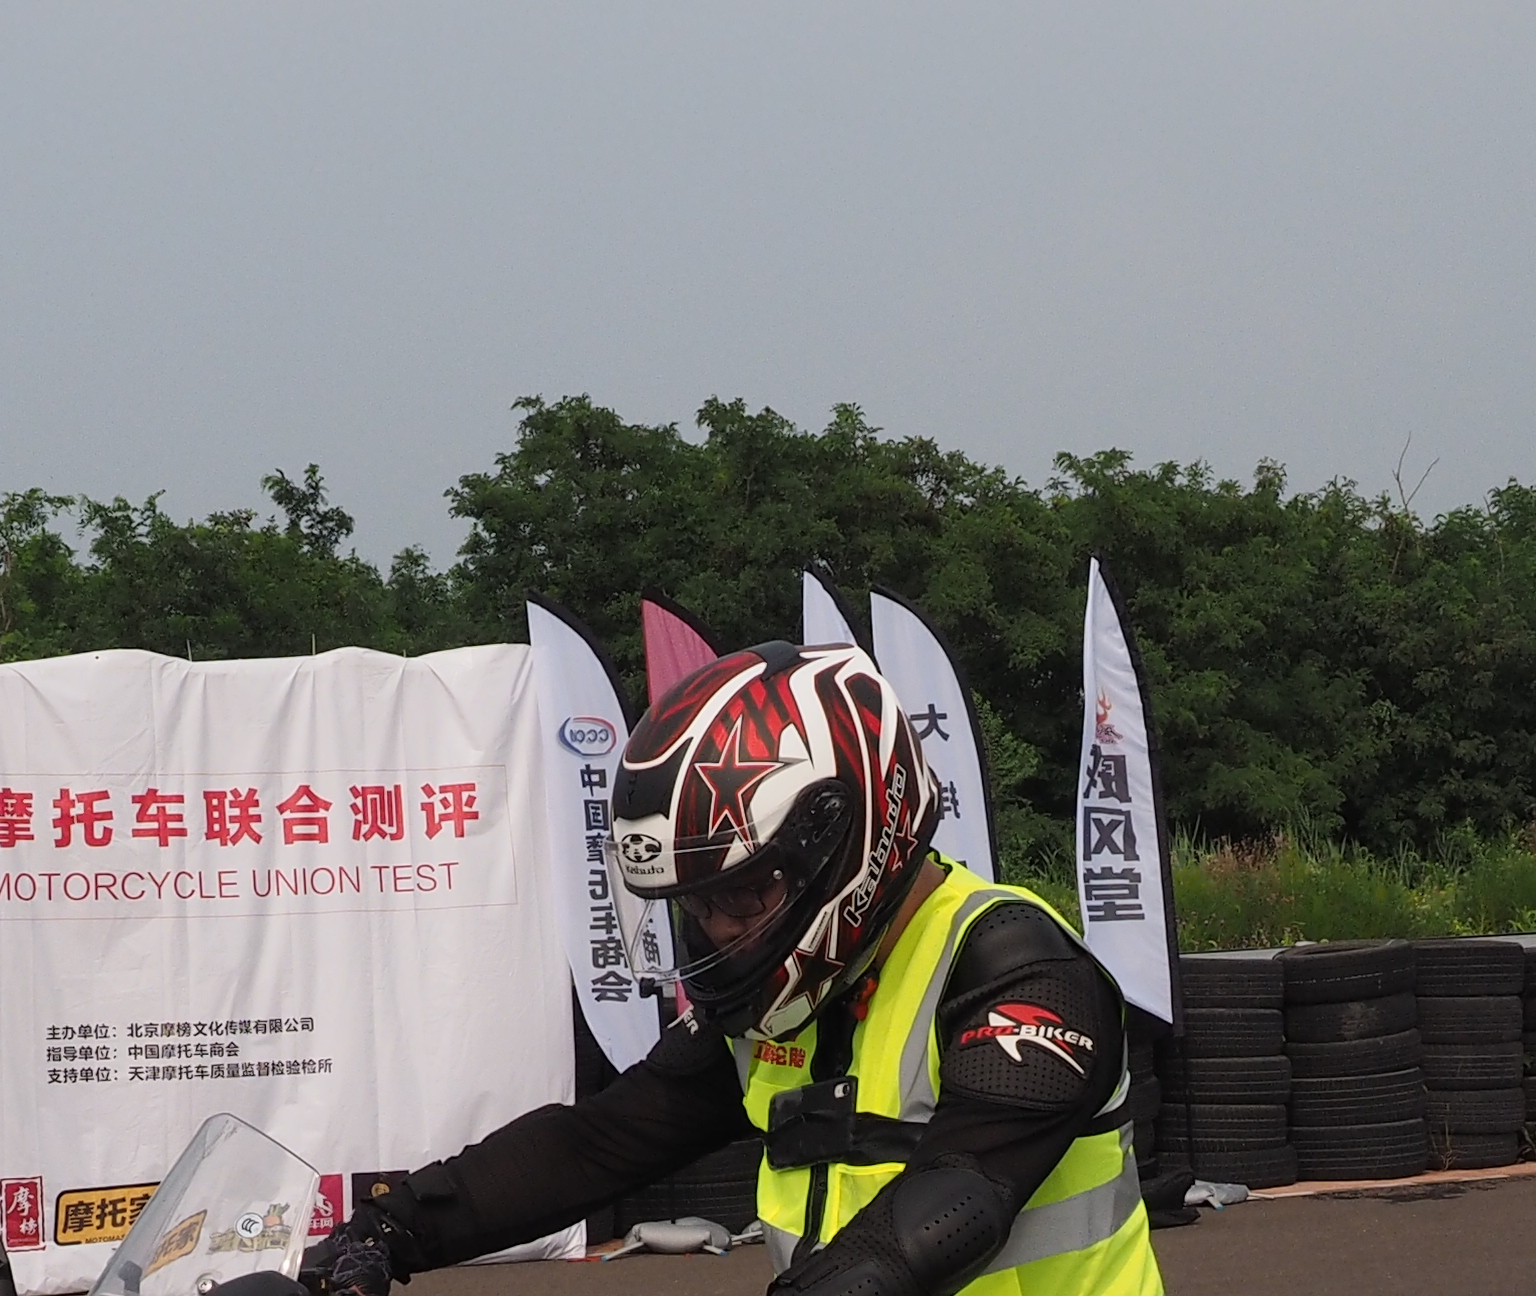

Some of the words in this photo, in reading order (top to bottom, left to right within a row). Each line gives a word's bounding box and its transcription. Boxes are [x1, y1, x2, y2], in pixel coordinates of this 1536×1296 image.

[251, 864, 362, 898] UNION
[371, 861, 458, 892] TEST
[960, 1022, 1095, 1052] PRO-BIKER
